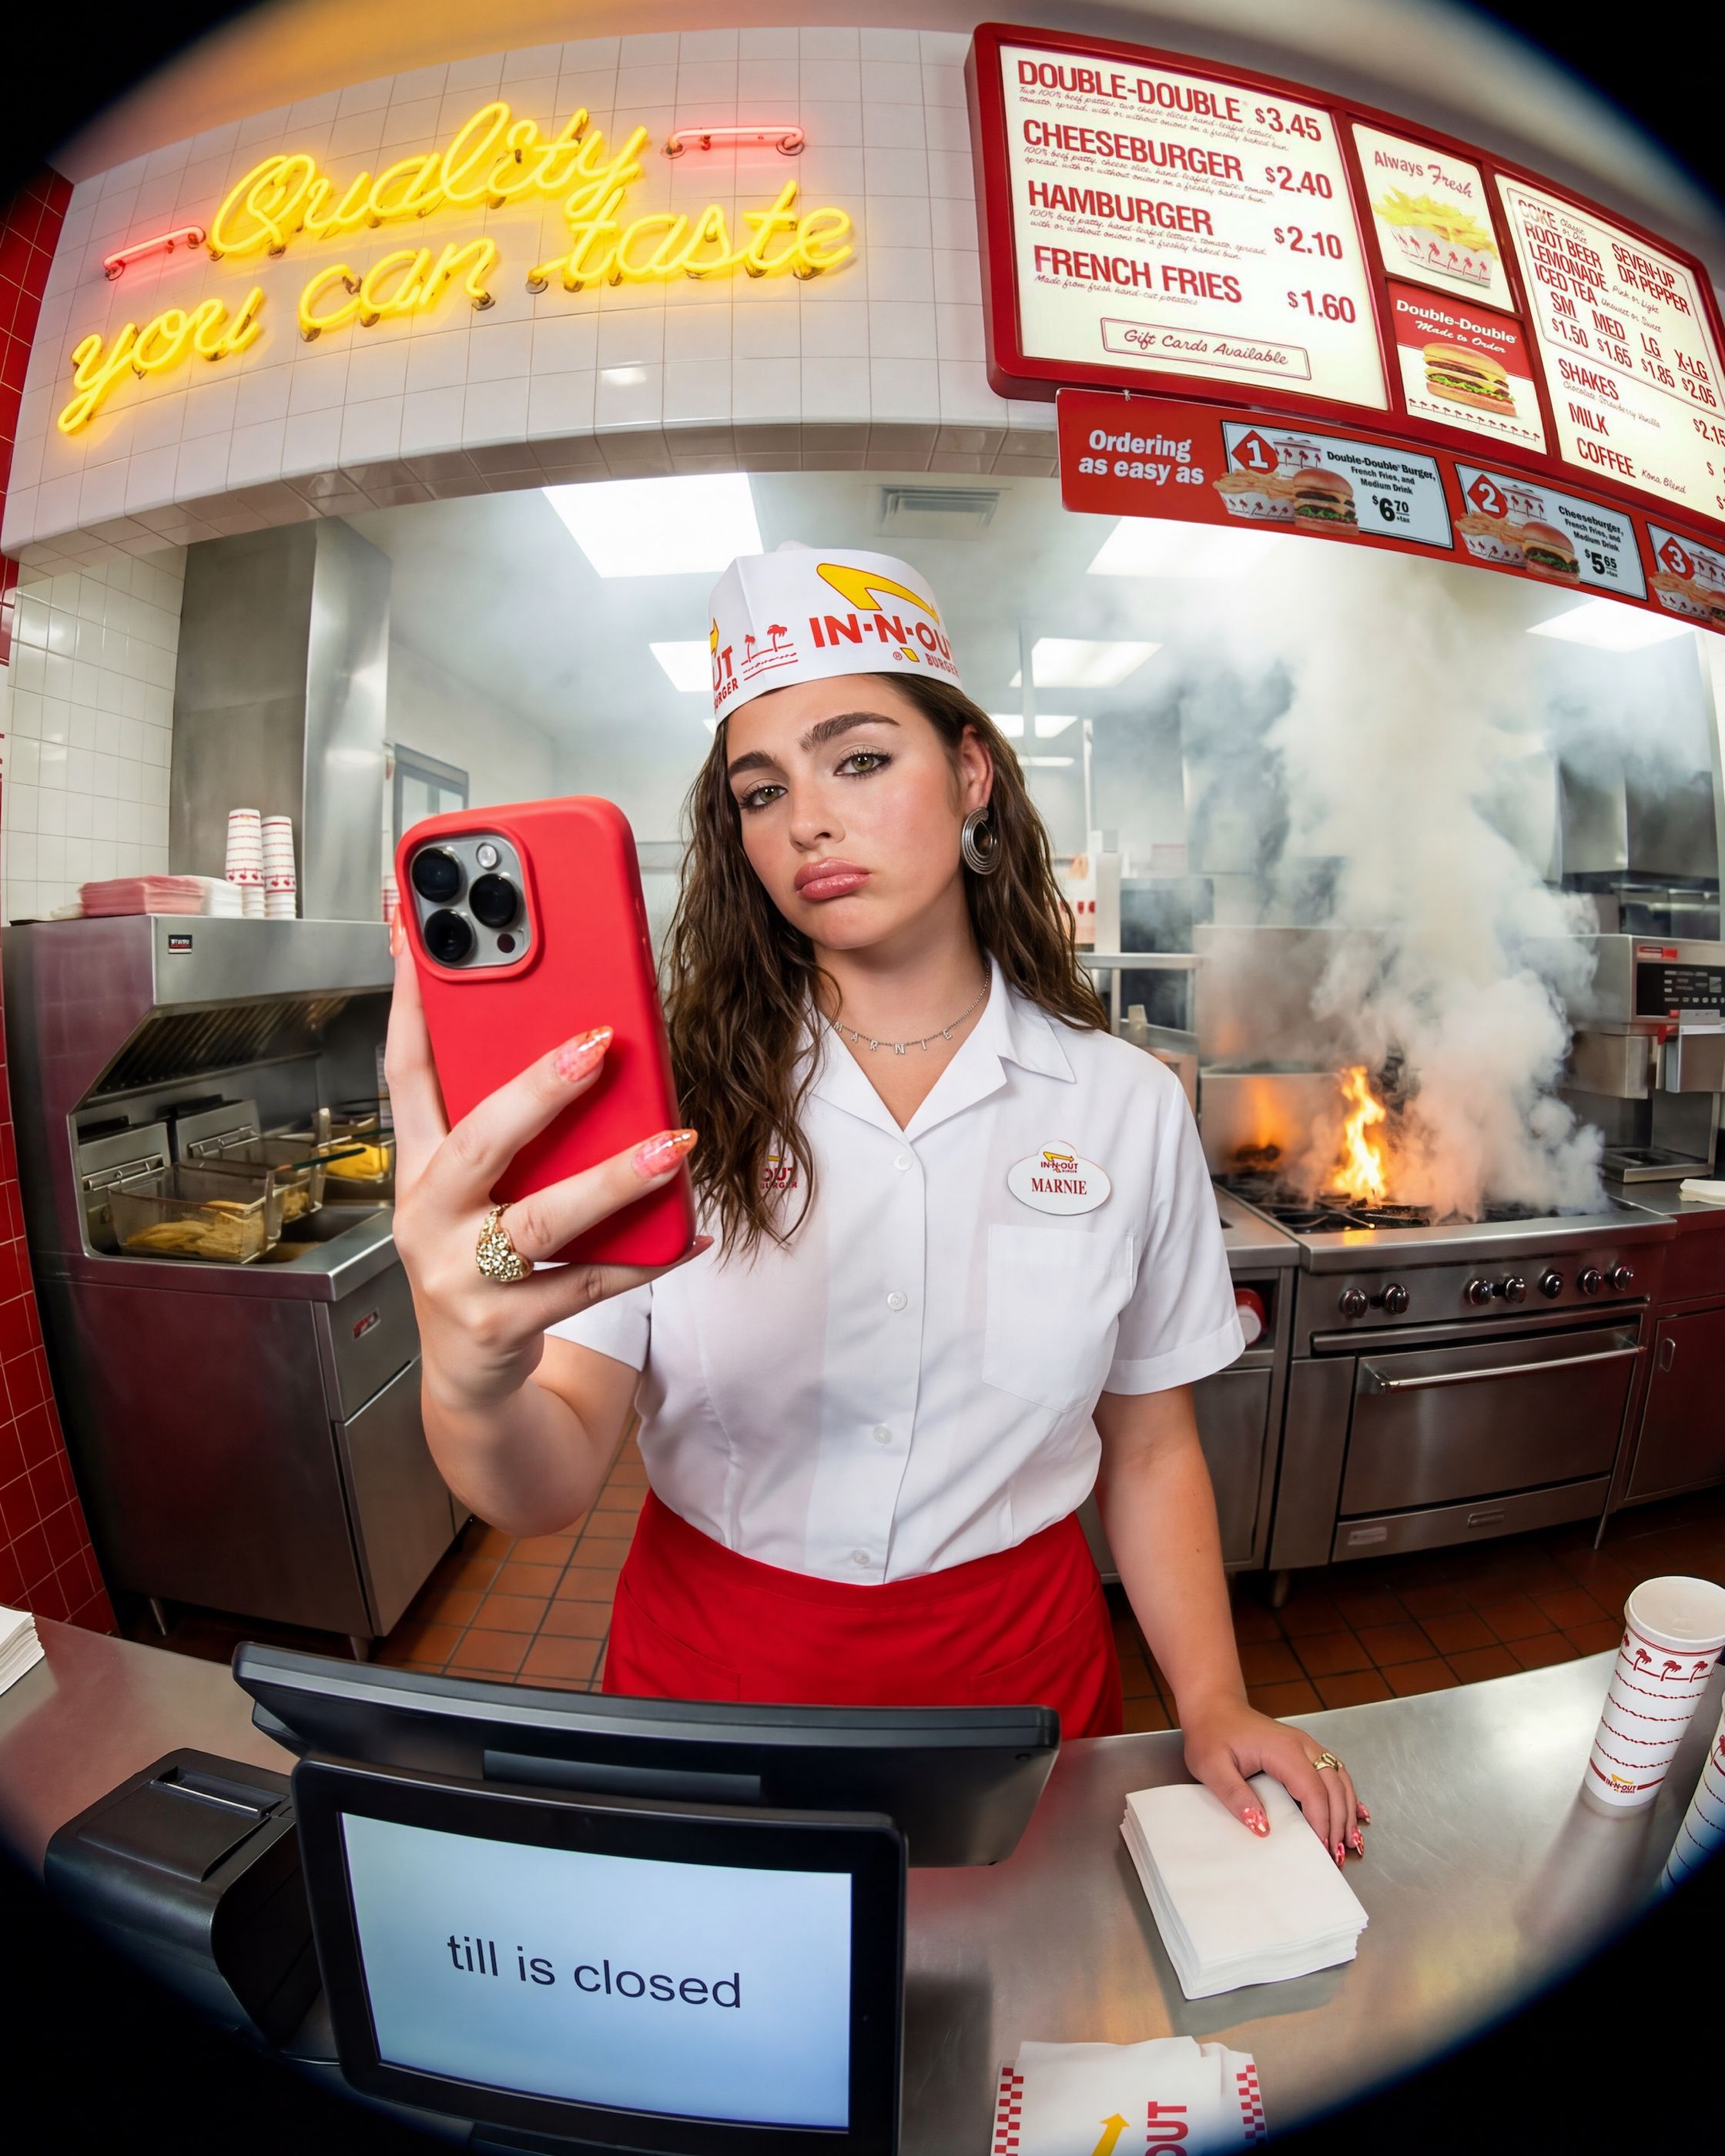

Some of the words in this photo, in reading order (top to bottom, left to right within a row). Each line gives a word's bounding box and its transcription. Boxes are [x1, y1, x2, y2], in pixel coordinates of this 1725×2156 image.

[1018, 60, 1242, 123] DOUBLE-DOUBLE
[1255, 107, 1321, 142] $3.45
[1125, 113, 1158, 125] without
[1160, 118, 1187, 129] onions
[1210, 128, 1239, 142] freshly
[1243, 136, 1269, 147] baked
[1023, 119, 1244, 182] CHEESEBURGER
[1265, 166, 1332, 199] $2.40
[1374, 150, 1424, 177] Always
[1428, 164, 1472, 198] Fresh
[206, 100, 648, 259] Quality
[1061, 162, 1081, 171] with
[1097, 168, 1131, 179] without
[1132, 174, 1160, 184] onions
[1184, 182, 1214, 196] freshly
[1218, 190, 1244, 200] baked
[1028, 180, 1214, 236] HAMBURGER
[1274, 226, 1343, 259] $2.10
[1030, 219, 1050, 229] with
[1067, 225, 1101, 236] without
[1103, 232, 1132, 241] onions
[1157, 239, 1189, 253] freshly
[1191, 246, 1219, 256] baked
[1560, 218, 1585, 235] Classic
[1523, 220, 1563, 251] ROOT
[1565, 238, 1603, 270] BEER
[1033, 245, 1152, 289] FRENCH
[1161, 264, 1242, 303] FRIES
[1288, 290, 1355, 323] $1.60
[1529, 240, 1609, 293] LEMONADE
[1534, 263, 1568, 292] ICED
[1569, 276, 1599, 307] TEA
[1611, 243, 1675, 289] SEVEN-UP
[57, 285, 264, 434] you
[297, 236, 497, 333] can
[528, 180, 853, 285] taste
[1035, 274, 1063, 286] Made
[1062, 278, 1086, 289] from
[1087, 283, 1112, 293] fresh
[1114, 286, 1158, 300] hand-cut
[1159, 293, 1197, 306] potatoes
[1617, 264, 1639, 290] DR
[1639, 274, 1691, 316] PEPPER
[1396, 299, 1516, 343] Double-Double
[1415, 320, 1454, 339] Made
[1456, 334, 1468, 343] to
[1472, 337, 1506, 353] Order
[1550, 291, 1577, 318] SM
[1592, 310, 1625, 340] MED
[1640, 333, 1662, 359] LG
[1674, 349, 1709, 381] X-LG
[1124, 329, 1156, 350] Gift
[1161, 334, 1208, 352] Cards
[1214, 343, 1288, 365] Available
[1552, 317, 1589, 349] $1.50
[1597, 338, 1633, 368] $1.65
[1640, 358, 1675, 388] $1.85
[1681, 377, 1717, 407] $2.05
[1558, 358, 1619, 401] SHAKES
[1568, 402, 1609, 437] MILK
[1089, 429, 1192, 463] Ordering
[1246, 439, 1269, 469] 1
[1078, 457, 1107, 475] as
[1114, 460, 1171, 486] easy
[1175, 465, 1204, 485] as
[1351, 466, 1377, 477] French
[1402, 477, 1415, 485] and
[1402, 464, 1436, 481] Burger,
[1576, 437, 1636, 479] COFFEE
[1641, 469, 1662, 484] Kona
[1663, 477, 1687, 494] Blend
[1360, 478, 1392, 490] Medium
[1392, 485, 1414, 495] Drink
[1478, 483, 1501, 514] 2
[1565, 518, 1588, 532] French
[1609, 534, 1621, 543] and
[1573, 531, 1601, 546] Medium
[1602, 540, 1620, 552] Drink
[1667, 545, 1686, 574] 3
[809, 613, 953, 661] IN-N-OU
[1040, 1161, 1078, 1170] IN-N-OUT
[1031, 1177, 1087, 1195] MARNIE
[447, 1935, 498, 1977] till
[517, 1945, 555, 1986] is
[574, 1959, 741, 2008] closed
